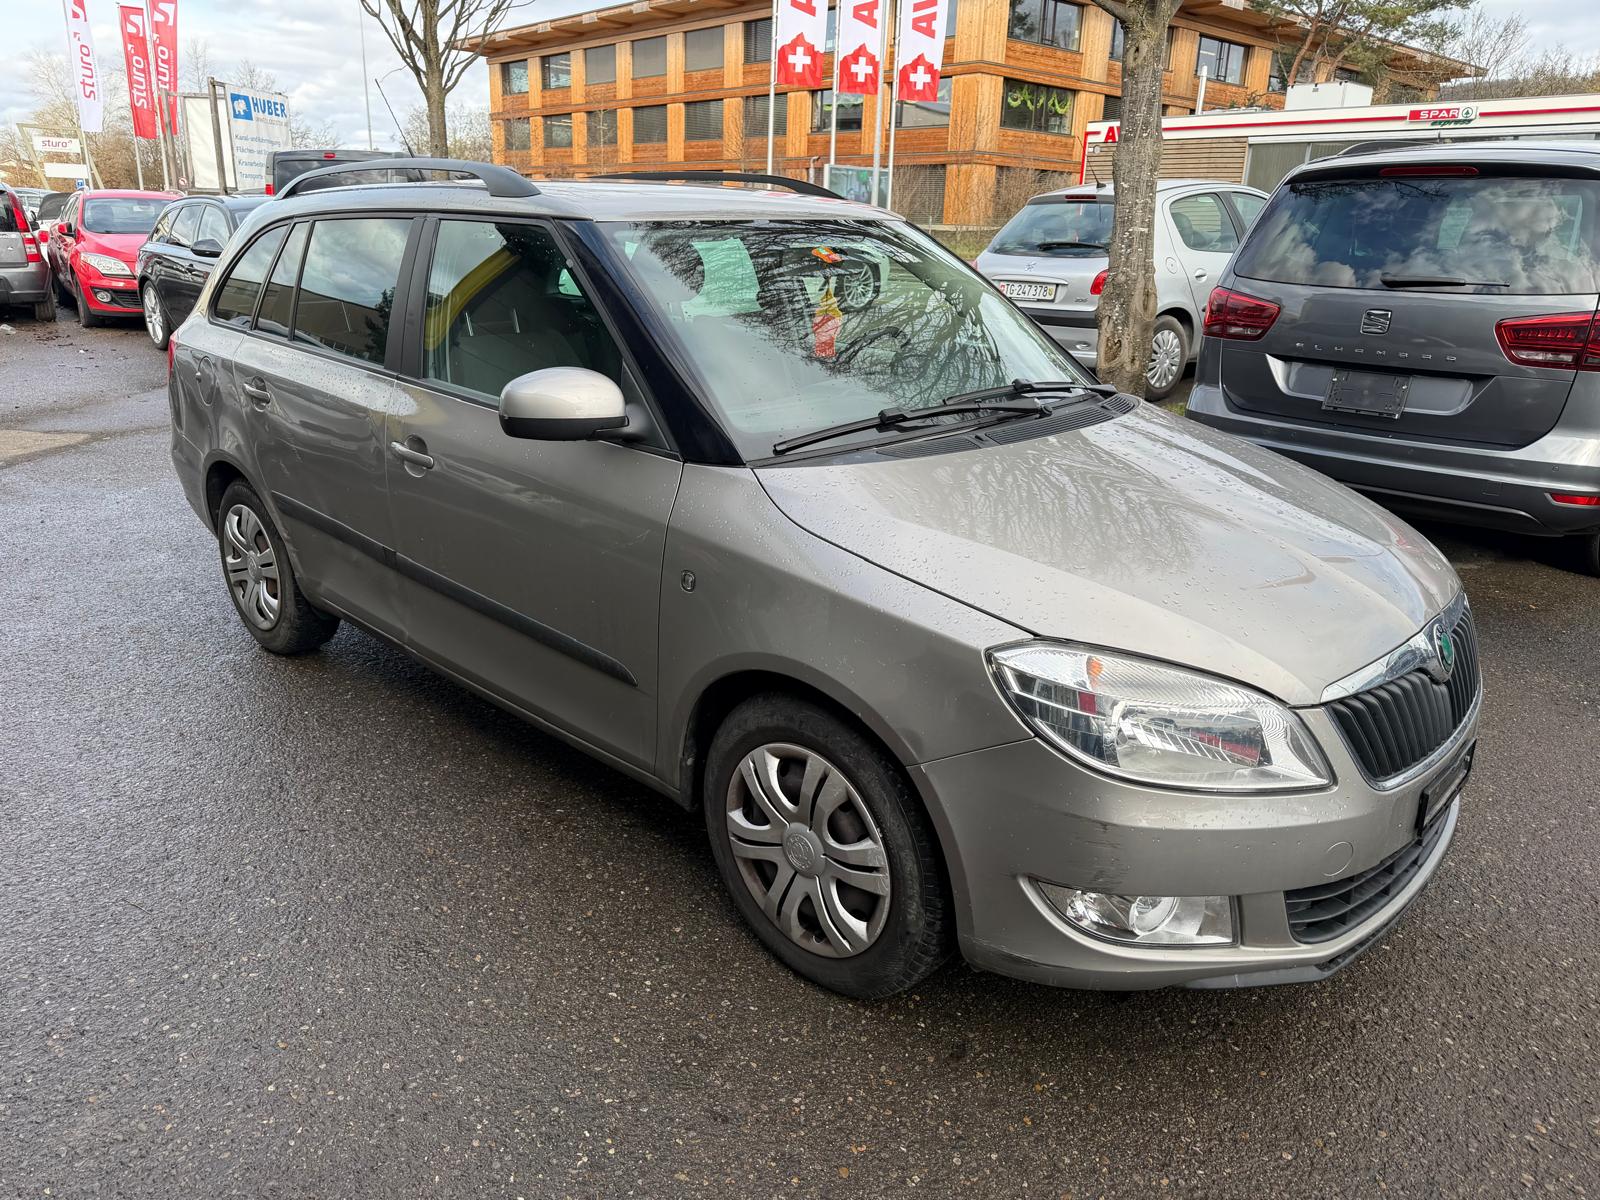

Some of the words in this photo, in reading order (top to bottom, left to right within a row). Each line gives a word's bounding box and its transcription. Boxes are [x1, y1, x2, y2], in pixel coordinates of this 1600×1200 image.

[79, 44, 96, 101] sturo
[131, 55, 148, 109] sturo
[157, 45, 169, 89] turo
[251, 97, 287, 118] HUBER
[1420, 109, 1459, 119] SPAR
[42, 140, 68, 148] sturo
